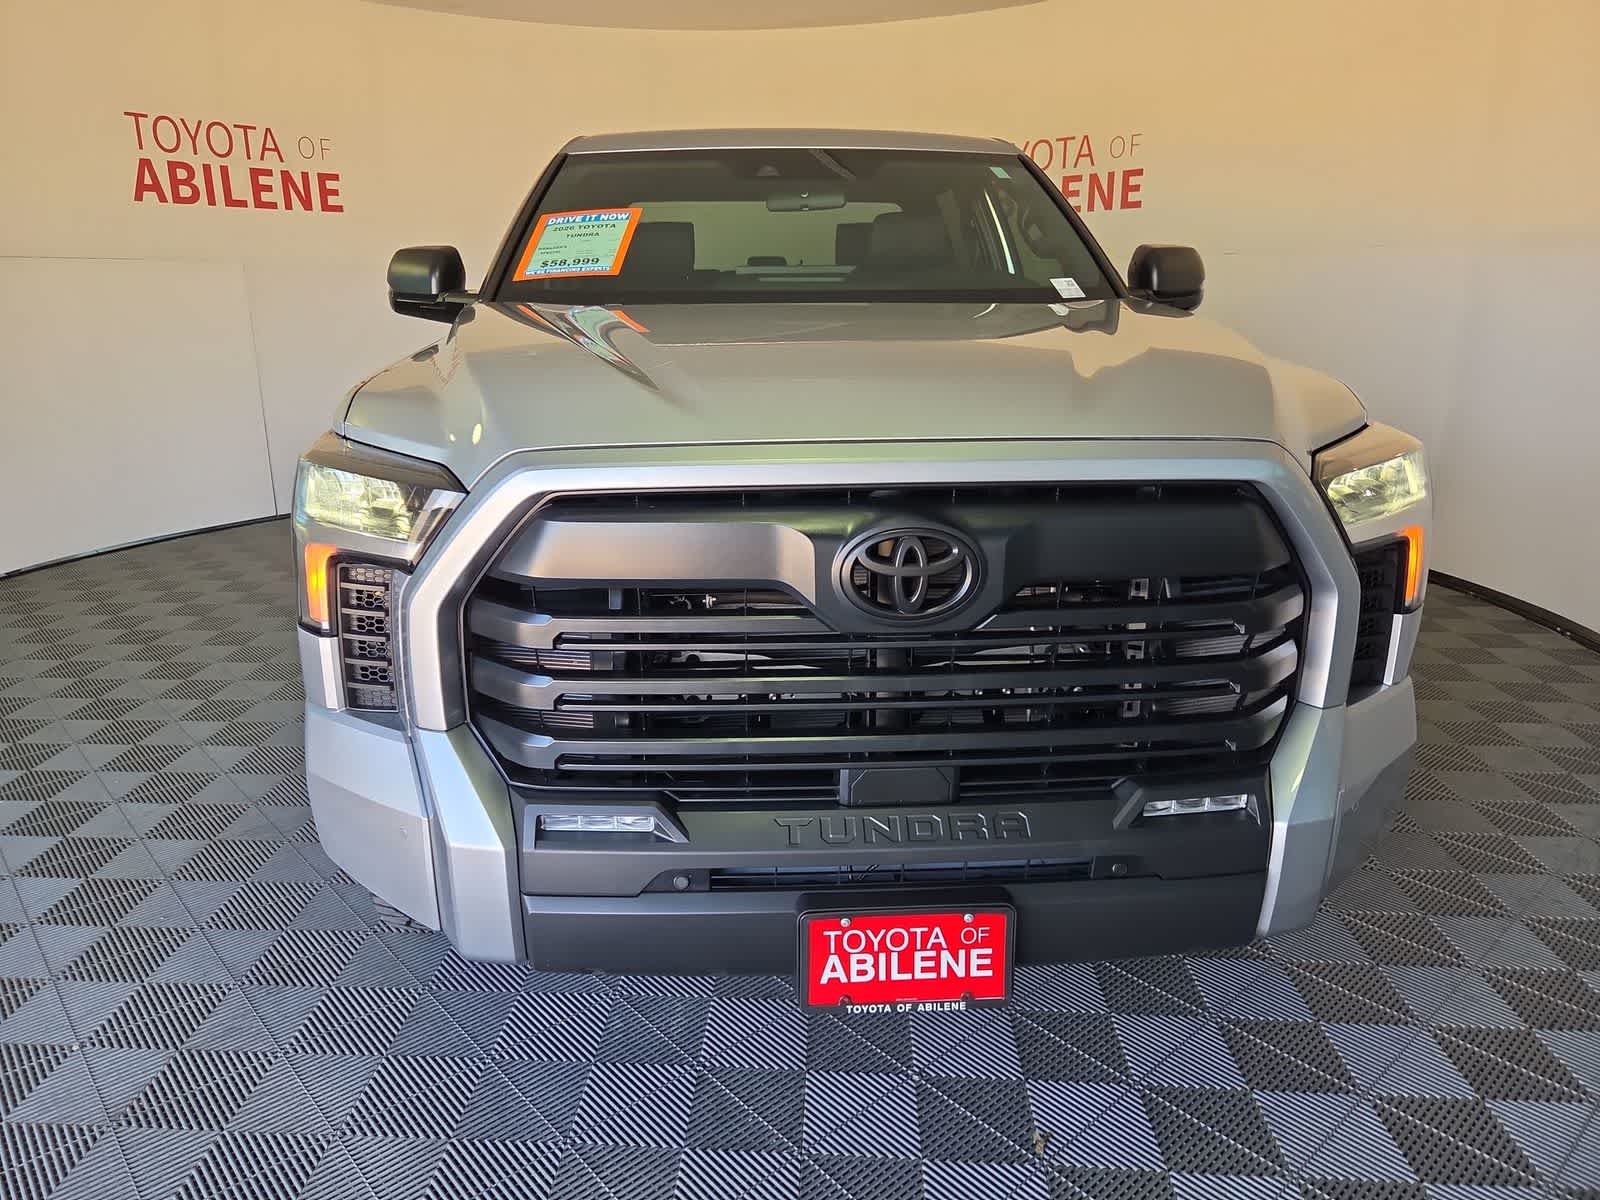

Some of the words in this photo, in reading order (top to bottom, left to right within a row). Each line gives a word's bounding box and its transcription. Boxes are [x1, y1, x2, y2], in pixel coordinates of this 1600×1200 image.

[123, 111, 285, 163] TOYOTA
[297, 135, 331, 161] OF
[1110, 133, 1144, 159] OF
[133, 157, 344, 213] ABILENE
[548, 215, 583, 225] DRIVE
[585, 214, 598, 222] IT
[600, 213, 629, 221] NOW
[578, 222, 617, 230] TOYOTA
[774, 811, 1032, 848] TUNDRA
[823, 926, 948, 954] TOYOTA
[960, 926, 991, 945] OF
[819, 947, 994, 986] ABILENE
[846, 1003, 891, 1014] TOYOTA
[897, 1003, 912, 1012] OF
[917, 1001, 967, 1012] ABILENE
